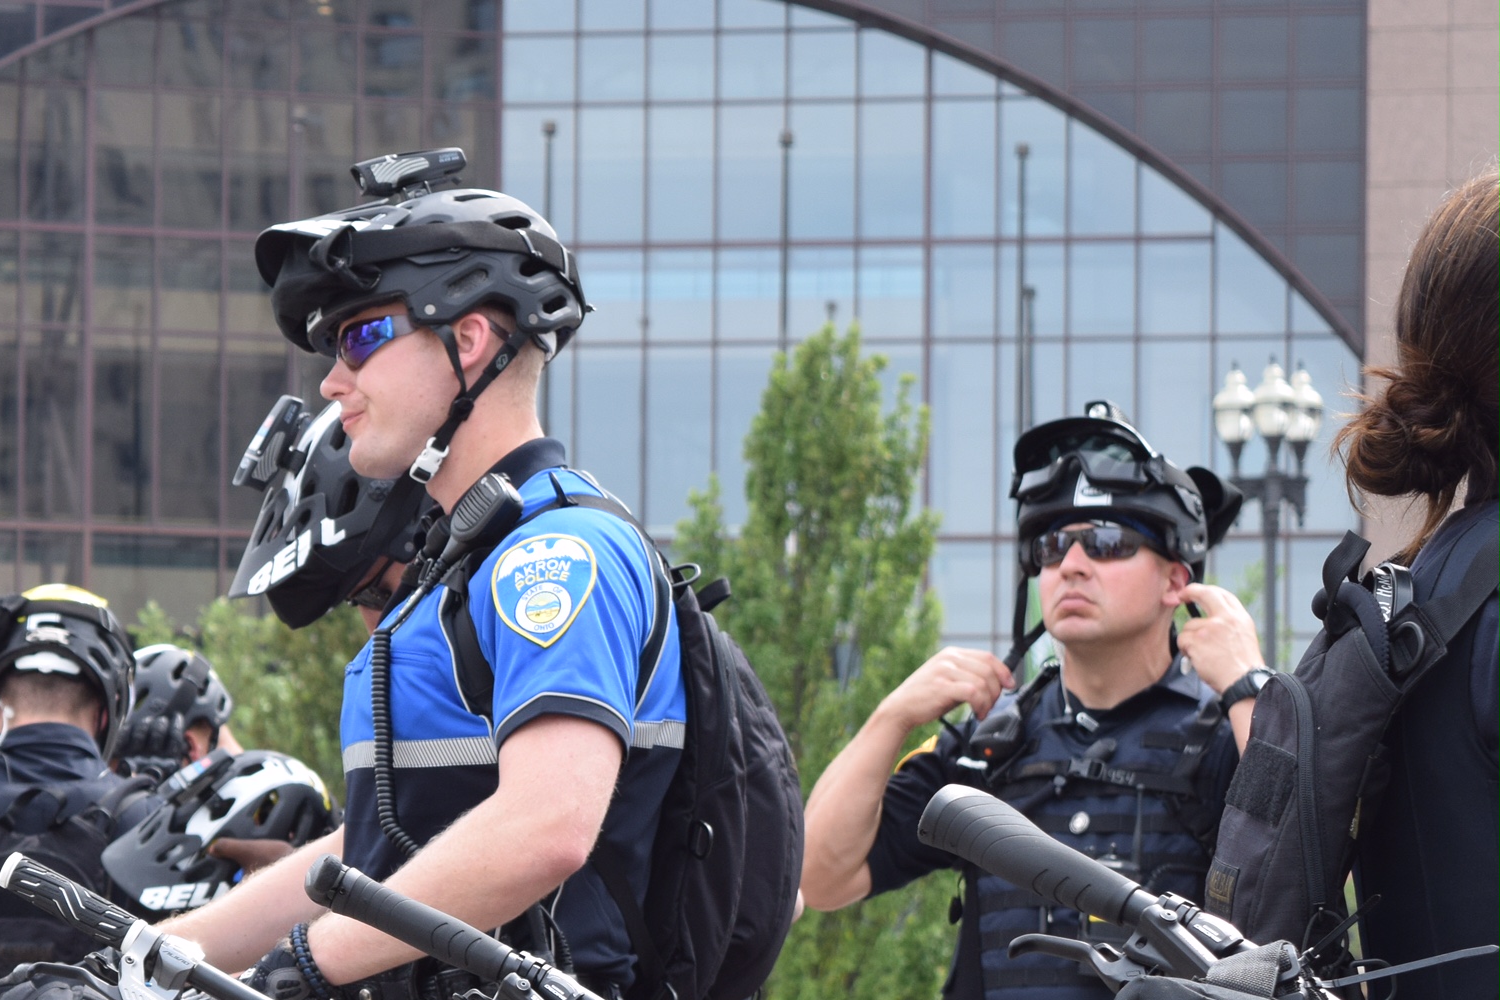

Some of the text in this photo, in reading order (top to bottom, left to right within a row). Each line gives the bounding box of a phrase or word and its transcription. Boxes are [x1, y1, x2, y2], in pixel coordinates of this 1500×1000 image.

[514, 559, 571, 583] AKRON
[515, 570, 570, 592] POLICE
[522, 585, 563, 601] STATE OF
[534, 622, 555, 632] OHIO
